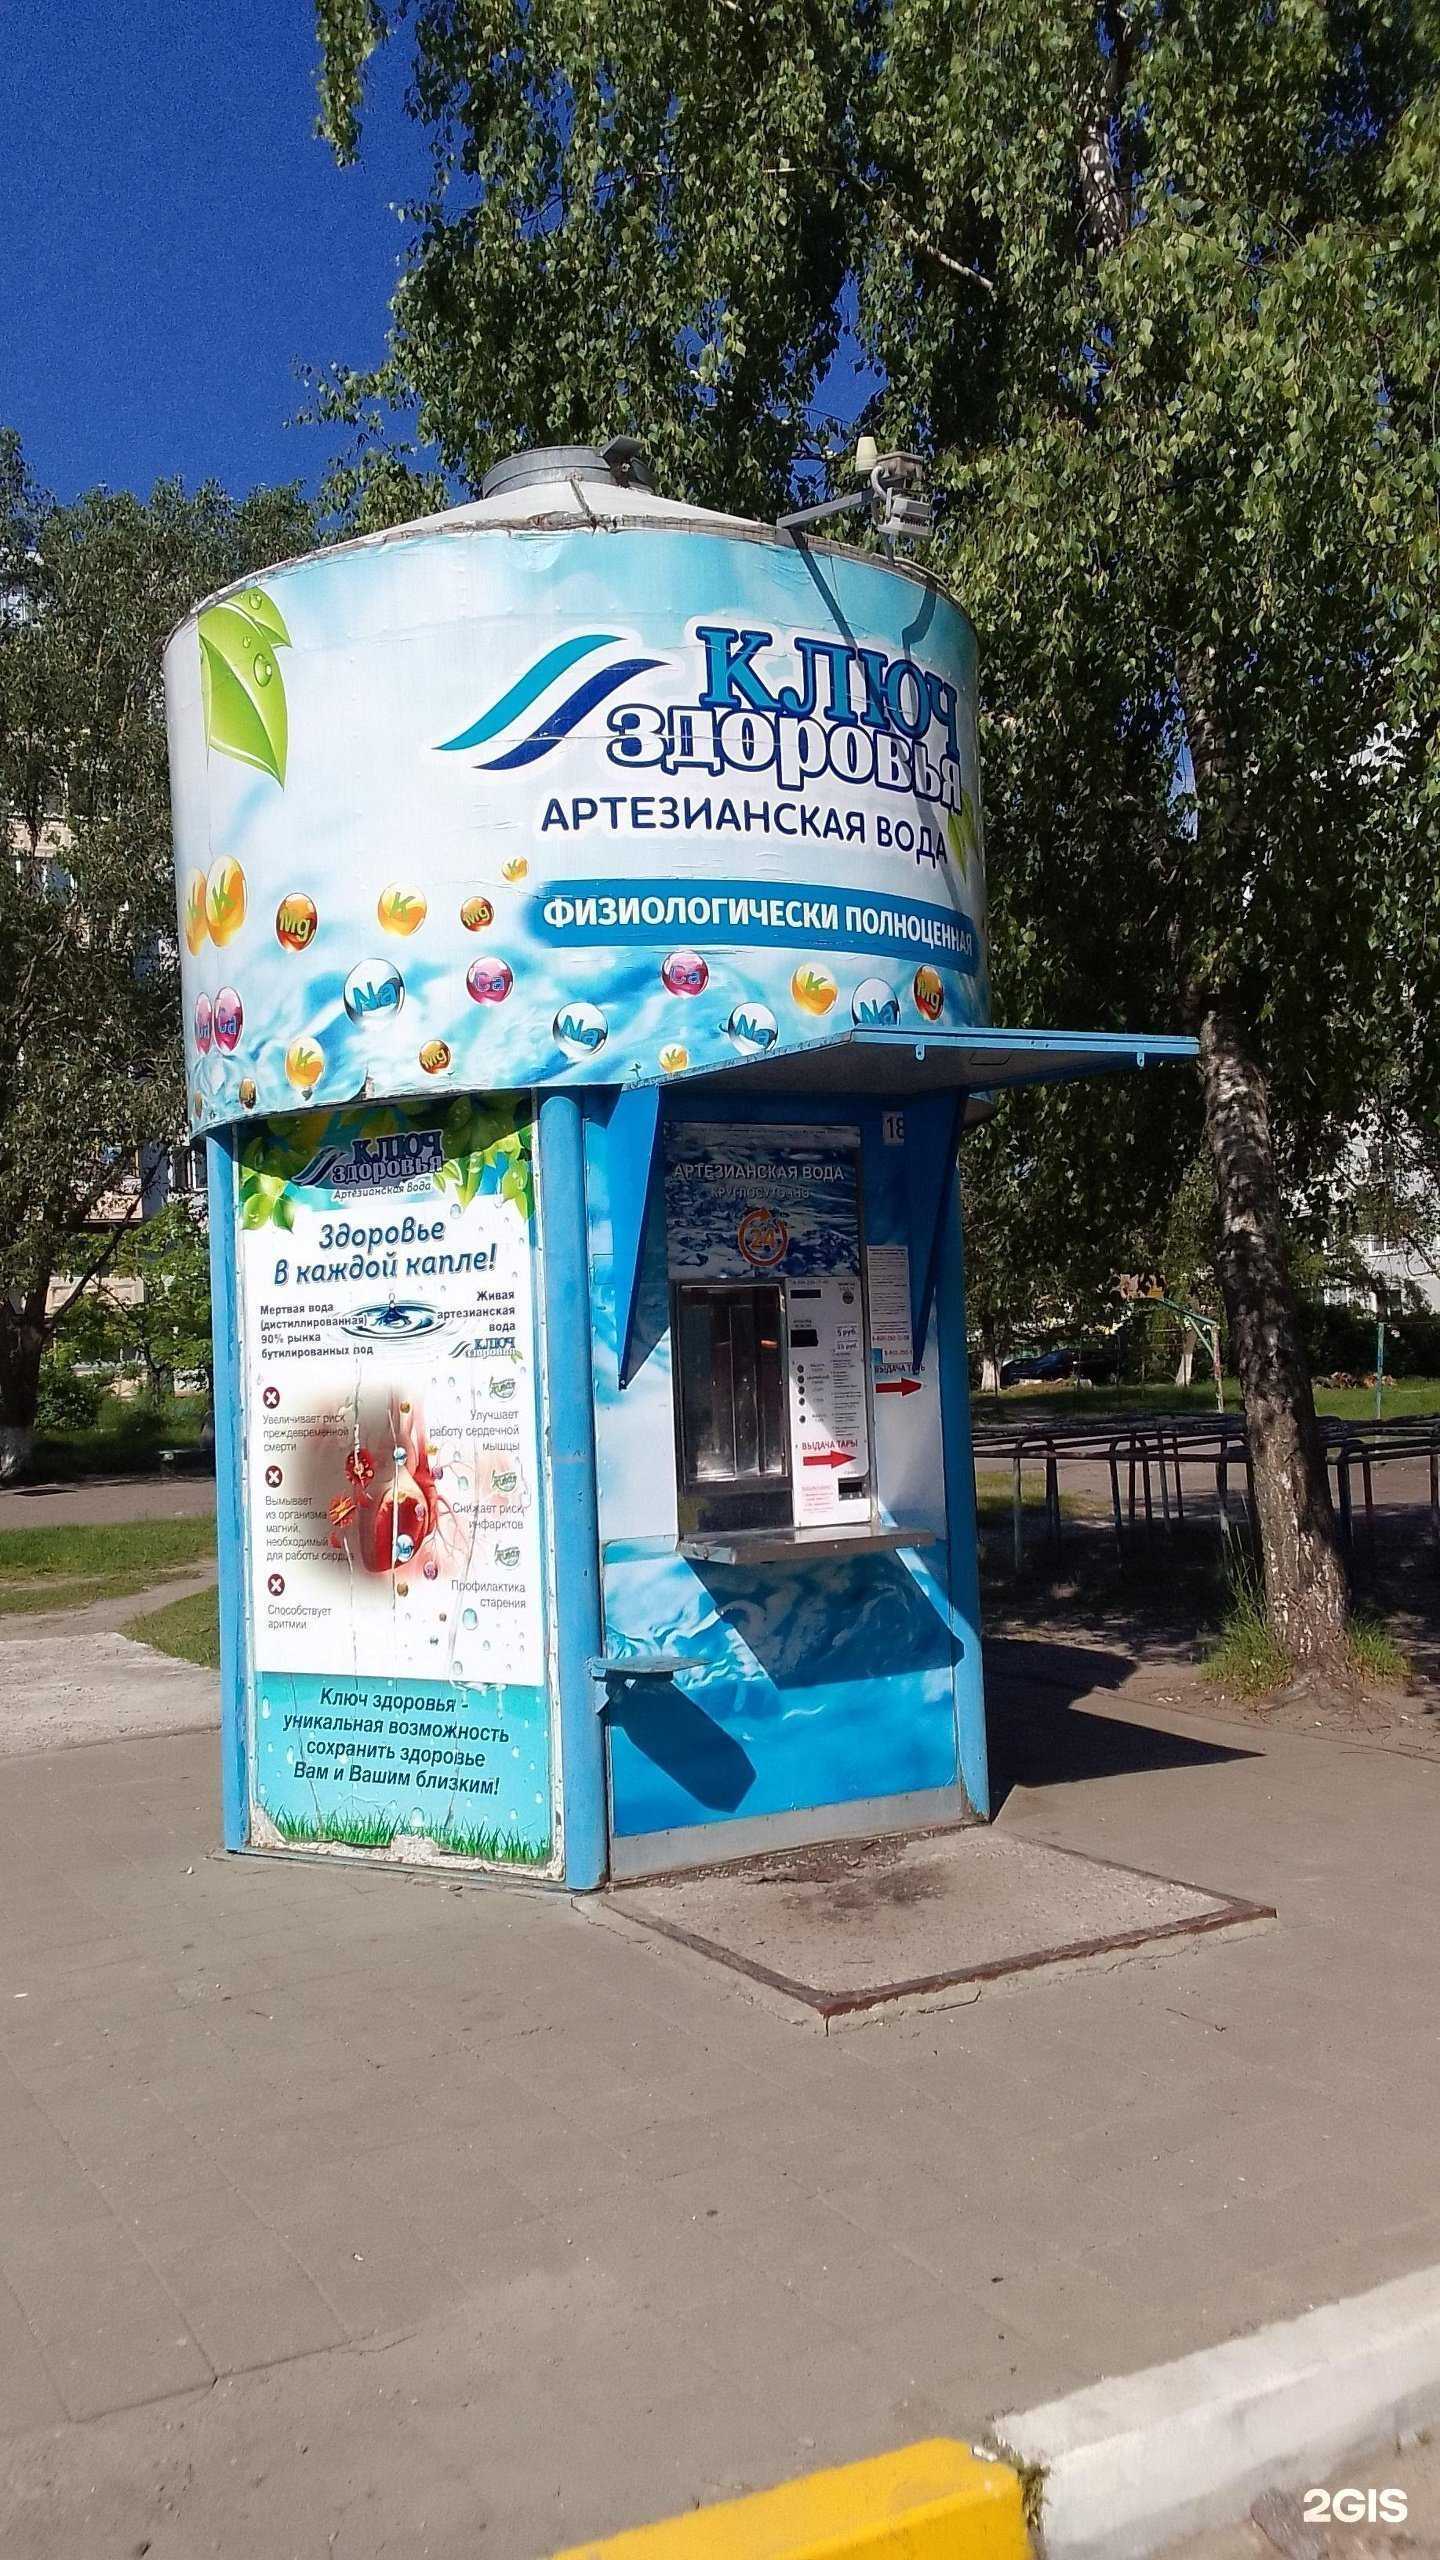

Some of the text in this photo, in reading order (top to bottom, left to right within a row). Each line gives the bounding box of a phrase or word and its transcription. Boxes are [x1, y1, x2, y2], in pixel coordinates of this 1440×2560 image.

[696, 626, 959, 761] КЛЮЧ
[541, 797, 949, 870] АРТЕЗИАНСКАЯ ВОДА
[464, 904, 489, 927] Mg
[279, 908, 312, 940] Mg
[543, 895, 974, 958] ФИЗИОЛОГИЧЕСКИ ПОЛНОЦЕННАЯ
[475, 972, 505, 993] Ca
[669, 964, 701, 985] Ca
[353, 981, 401, 1018] Na
[917, 981, 941, 1011] Mg
[558, 1014, 601, 1047] Na
[736, 1013, 771, 1047] Na
[422, 1048, 447, 1071] Mg
[351, 1129, 444, 1164] КЛЮЧ
[674, 1162, 845, 1183] АРТЕЗИАНСКАЯ ВОДА
[334, 1183, 405, 1200] Артезианская
[318, 1216, 446, 1256] Здоровье
[750, 1229, 777, 1250] 24
[296, 1252, 399, 1284] каждой
[404, 1243, 497, 1278] капле!
[476, 1290, 516, 1302] Живая
[260, 1303, 334, 1317] Мертвая вода
[437, 1306, 516, 1321] артезианская
[260, 1314, 368, 1332] (дистиллированная)
[488, 1322, 516, 1333] вода
[261, 1333, 322, 1345] 90% рынка
[261, 1346, 350, 1361] бутилированных
[262, 1413, 346, 1426] Увеличивает риск
[470, 1408, 520, 1422] Улучшает
[263, 1427, 350, 1439] преждевременной
[429, 1424, 520, 1439] работу сердечной
[263, 1442, 297, 1453] смерти
[482, 1441, 520, 1453] мышцы
[802, 1439, 858, 1451] ВЫДАЧА ТАРЫ
[265, 1495, 313, 1506] Вымывает
[265, 1510, 328, 1521] из организма
[500, 1503, 524, 1516] риск
[469, 1519, 524, 1532] инфарктов
[266, 1536, 329, 1549] необходимый
[266, 1551, 283, 1562] для
[285, 1550, 319, 1562] работы
[451, 1579, 526, 1593] Профилактика
[267, 1604, 332, 1618] Способствует
[480, 1598, 526, 1610] старения
[268, 1619, 307, 1630] аритмии
[321, 1687, 367, 1707] Ключ
[373, 1692, 456, 1713] здоровья
[282, 1713, 510, 1743] уникальная возможность
[306, 1739, 486, 1768] сохранить здоровье
[294, 1761, 500, 1796] Вам и Вашим близким!
